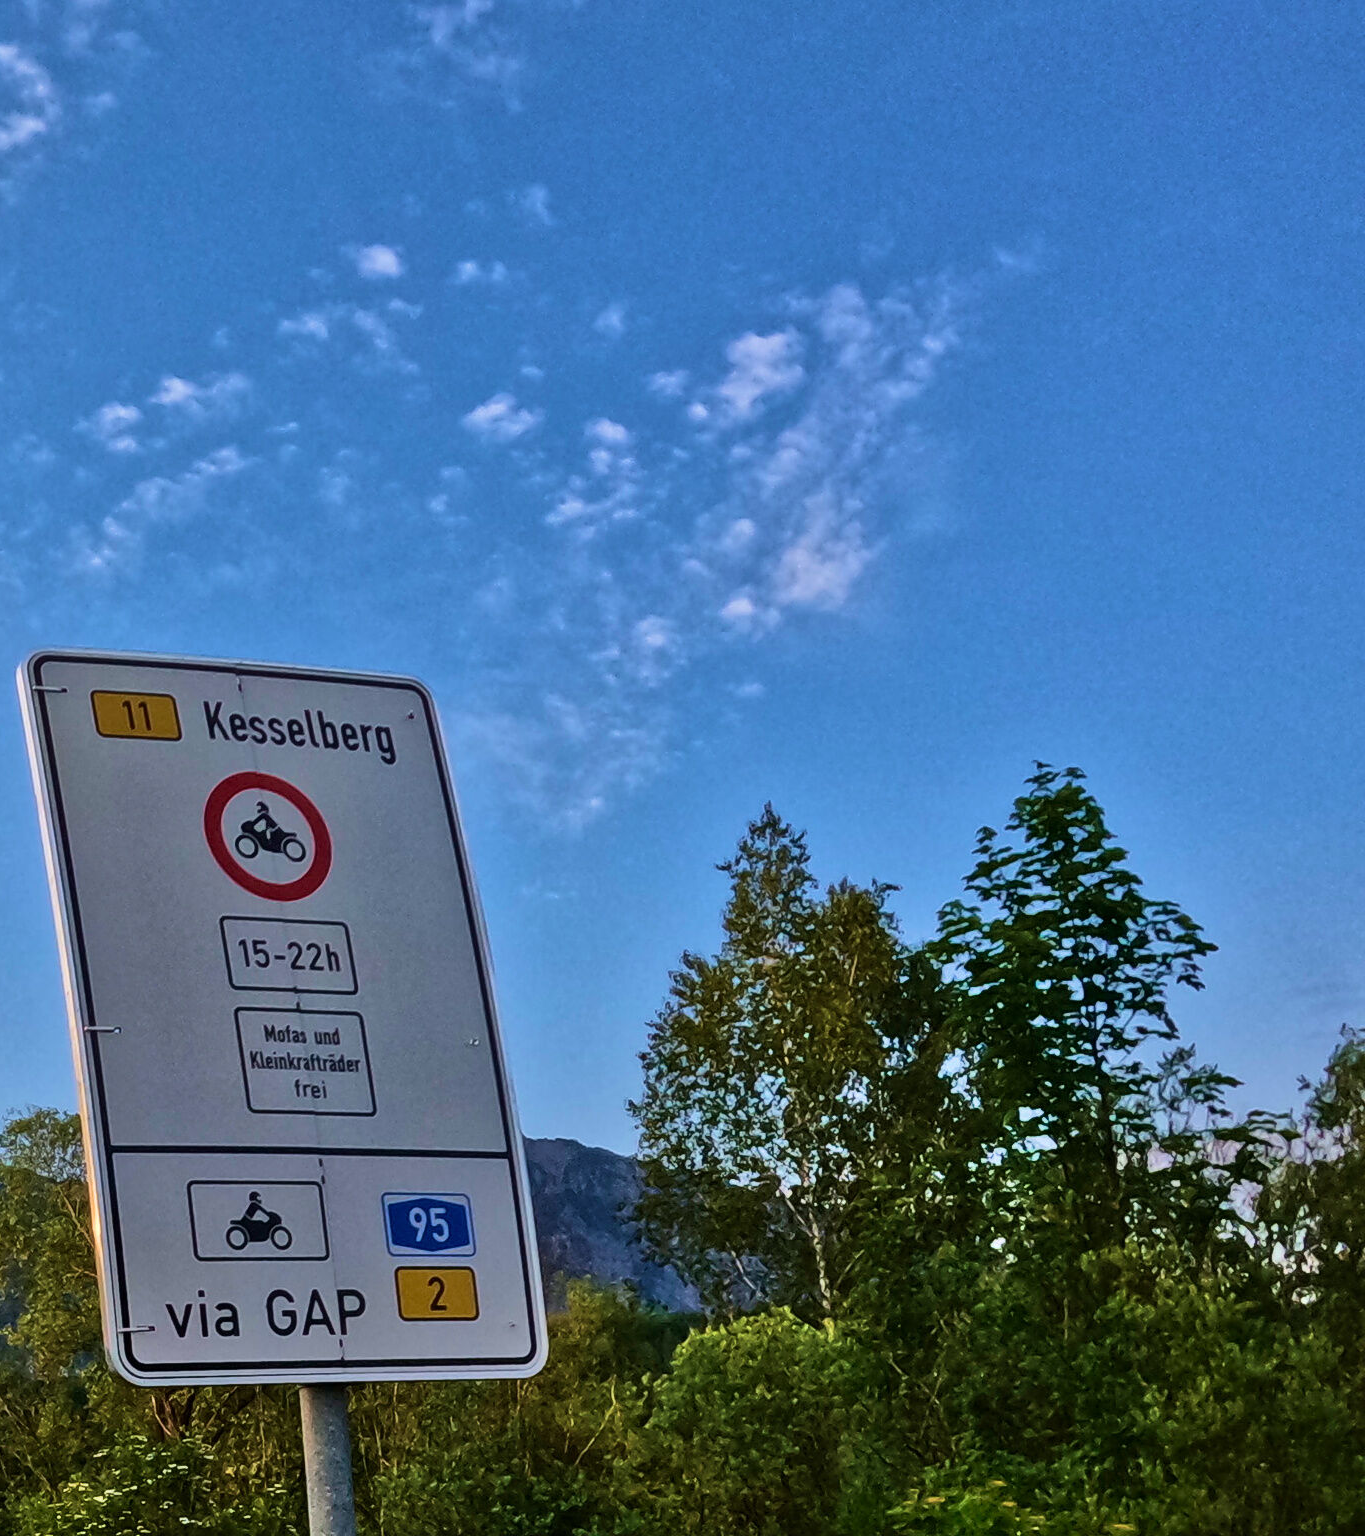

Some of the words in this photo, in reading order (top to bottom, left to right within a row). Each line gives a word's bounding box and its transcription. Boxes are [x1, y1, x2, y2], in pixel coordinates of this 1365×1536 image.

[122, 700, 152, 731] 11
[203, 701, 396, 765] Kesselberg
[238, 939, 341, 972] 15-22h
[263, 1024, 307, 1044] Mofas
[314, 1027, 340, 1045] und
[249, 1051, 361, 1073] Kleinkrafträder
[294, 1079, 327, 1099] frei
[408, 1207, 450, 1243] 95
[427, 1276, 447, 1312] 2
[165, 1290, 240, 1338] via
[266, 1289, 366, 1337] GAP
